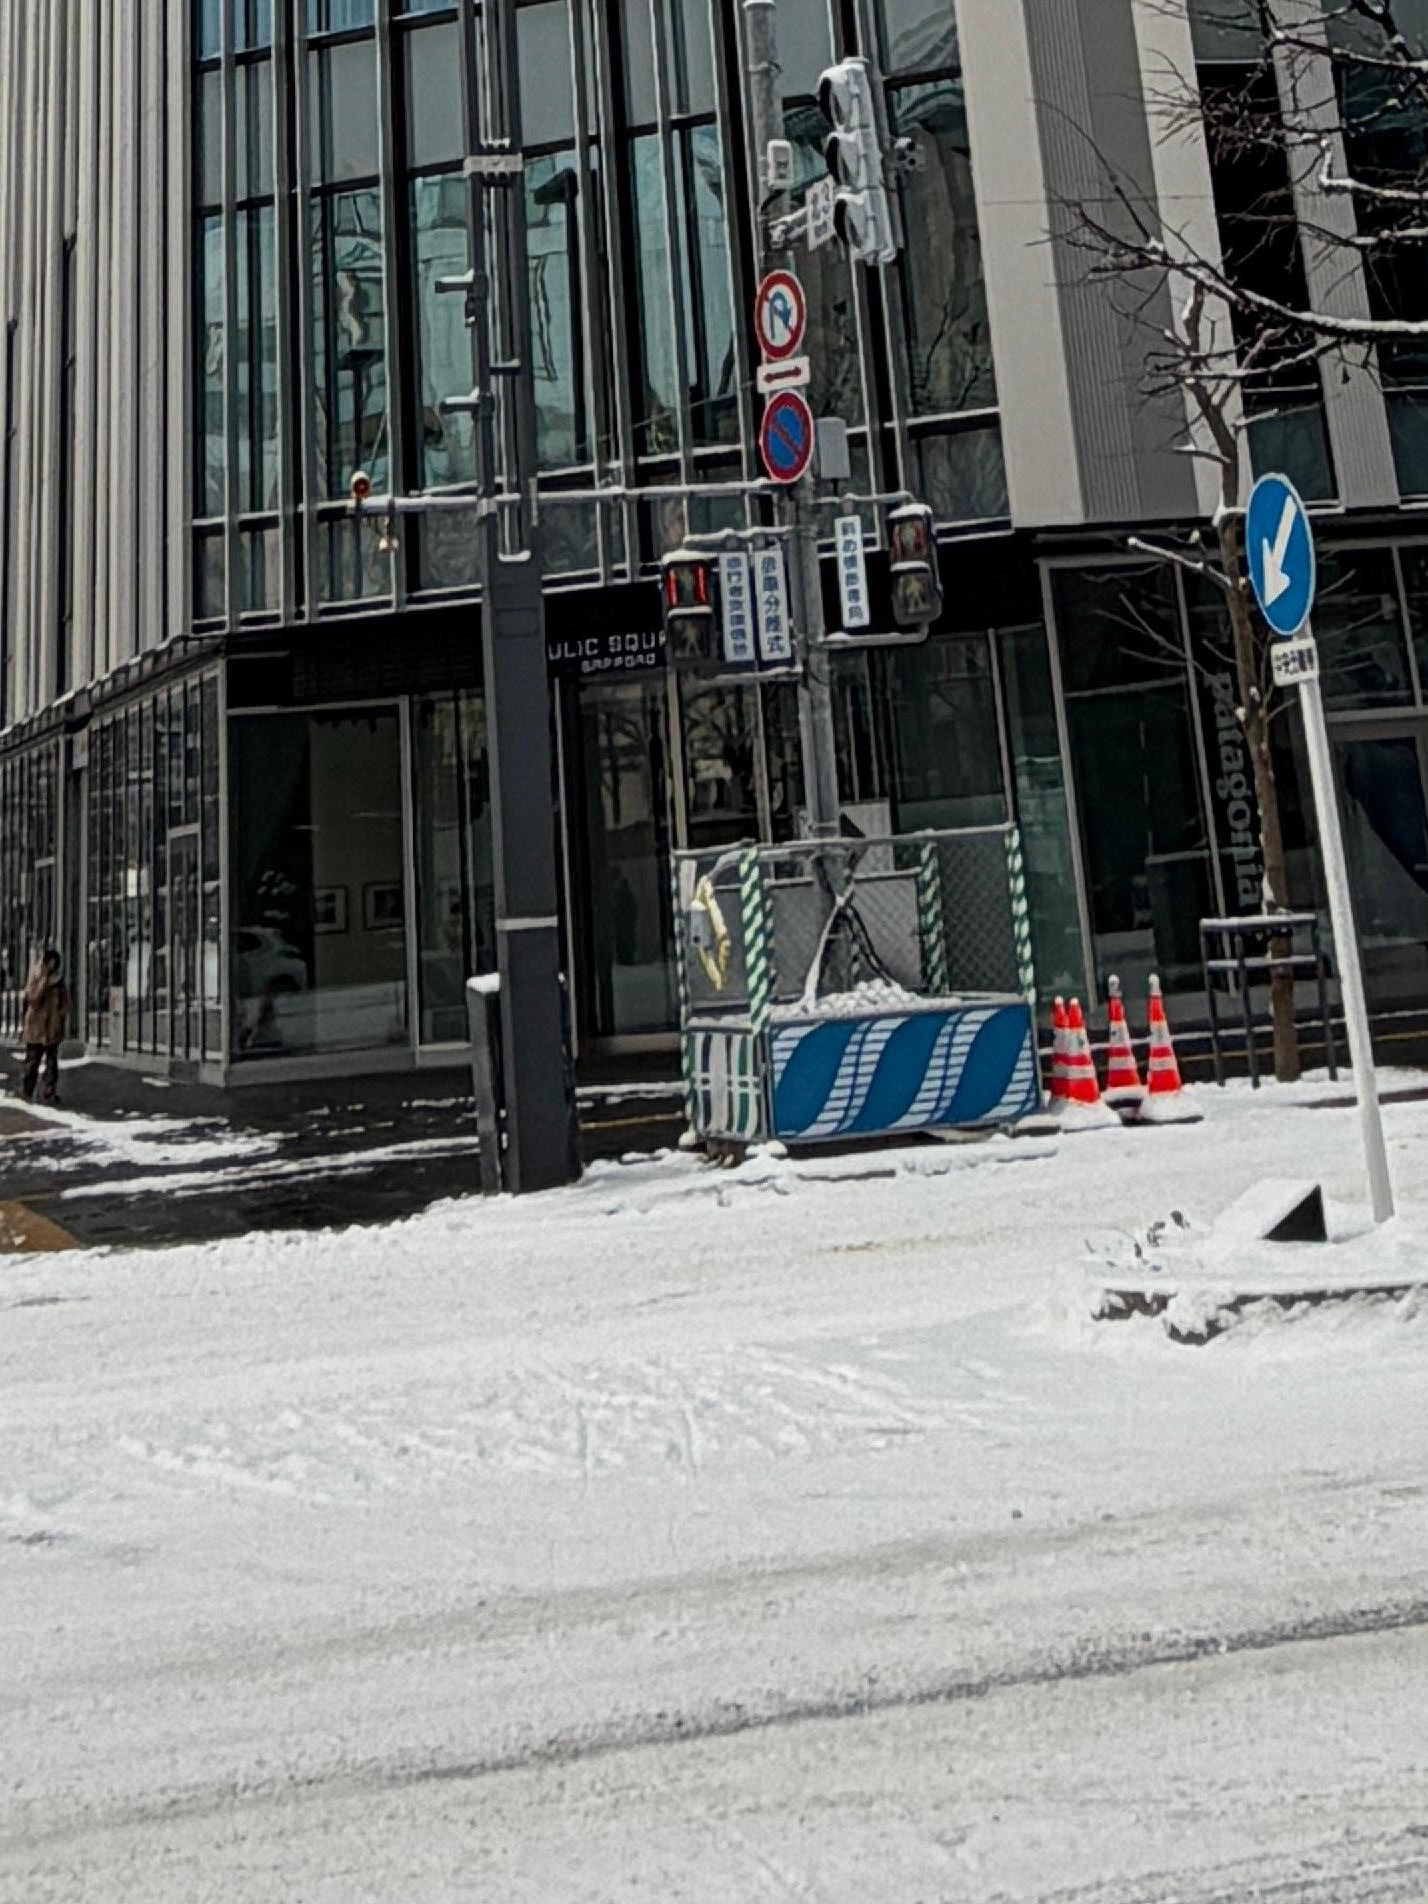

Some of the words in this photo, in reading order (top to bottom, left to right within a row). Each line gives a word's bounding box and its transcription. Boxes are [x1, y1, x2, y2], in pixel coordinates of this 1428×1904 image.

[548, 637, 599, 661] ULIC
[581, 652, 656, 673] SAPPORO
[1211, 672, 1264, 908] patagonia
